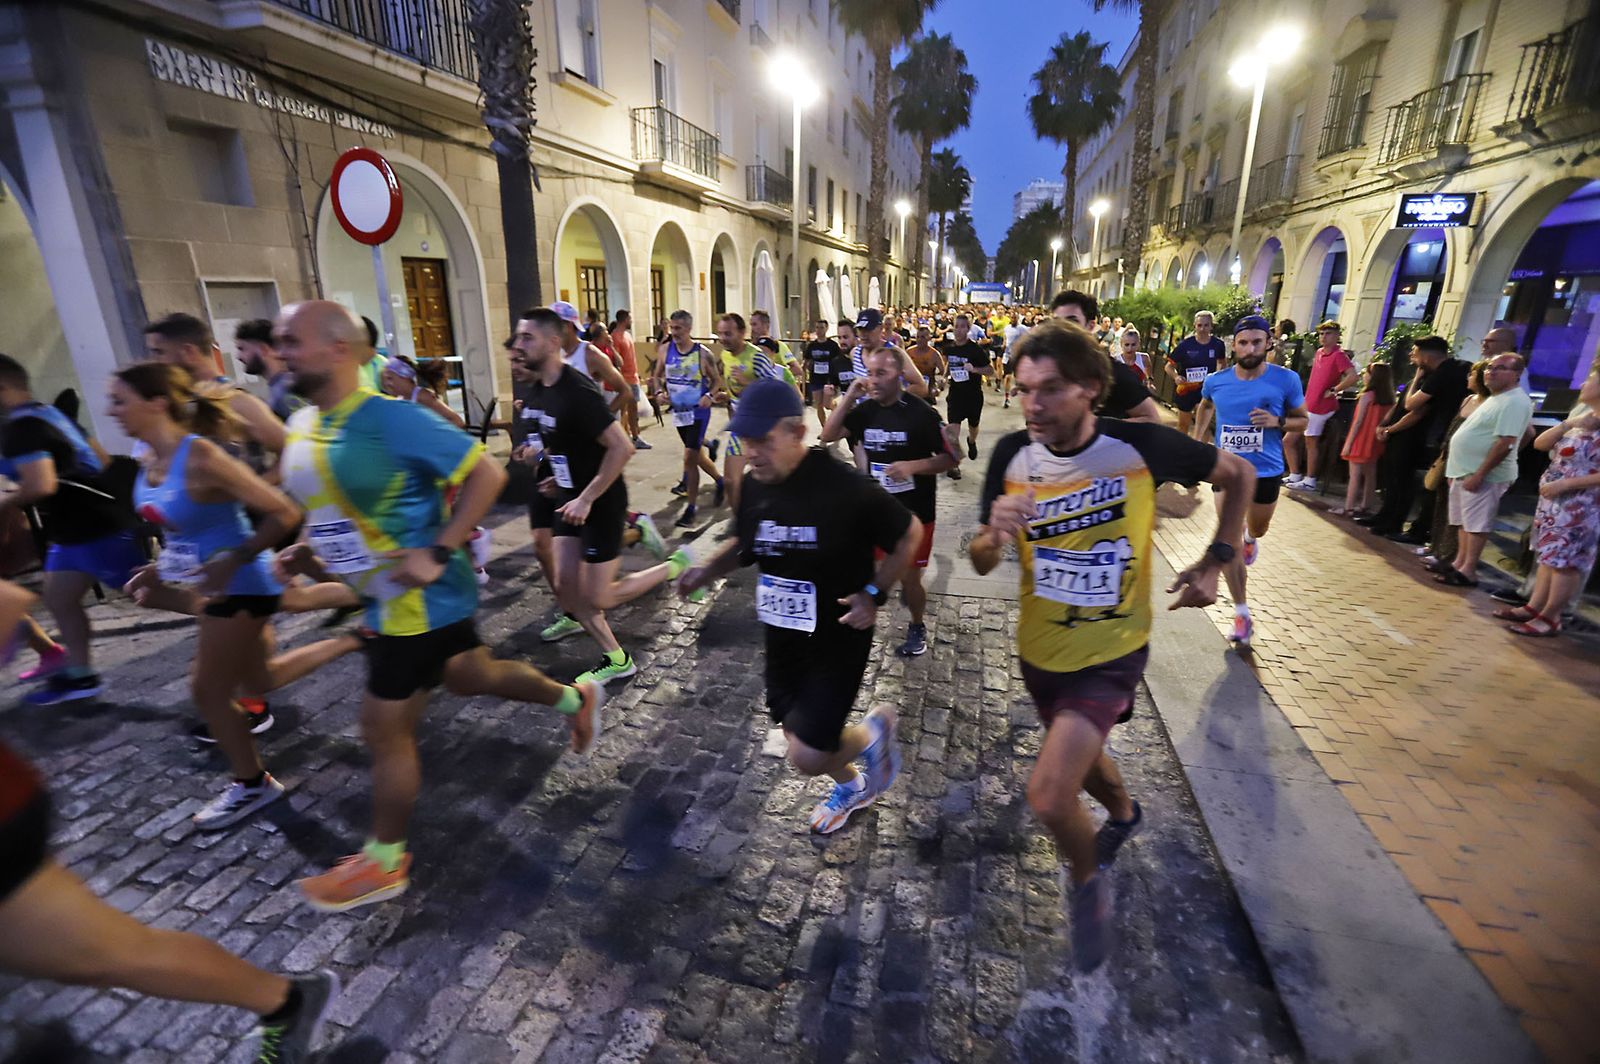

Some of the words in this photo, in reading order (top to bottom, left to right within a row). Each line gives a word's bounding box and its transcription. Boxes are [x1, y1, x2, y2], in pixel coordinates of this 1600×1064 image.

[149, 41, 256, 87] AVENIDA
[150, 60, 248, 103] MARTIN
[1230, 436, 1250, 446] 490
[1046, 510, 1113, 536] TERSIO
